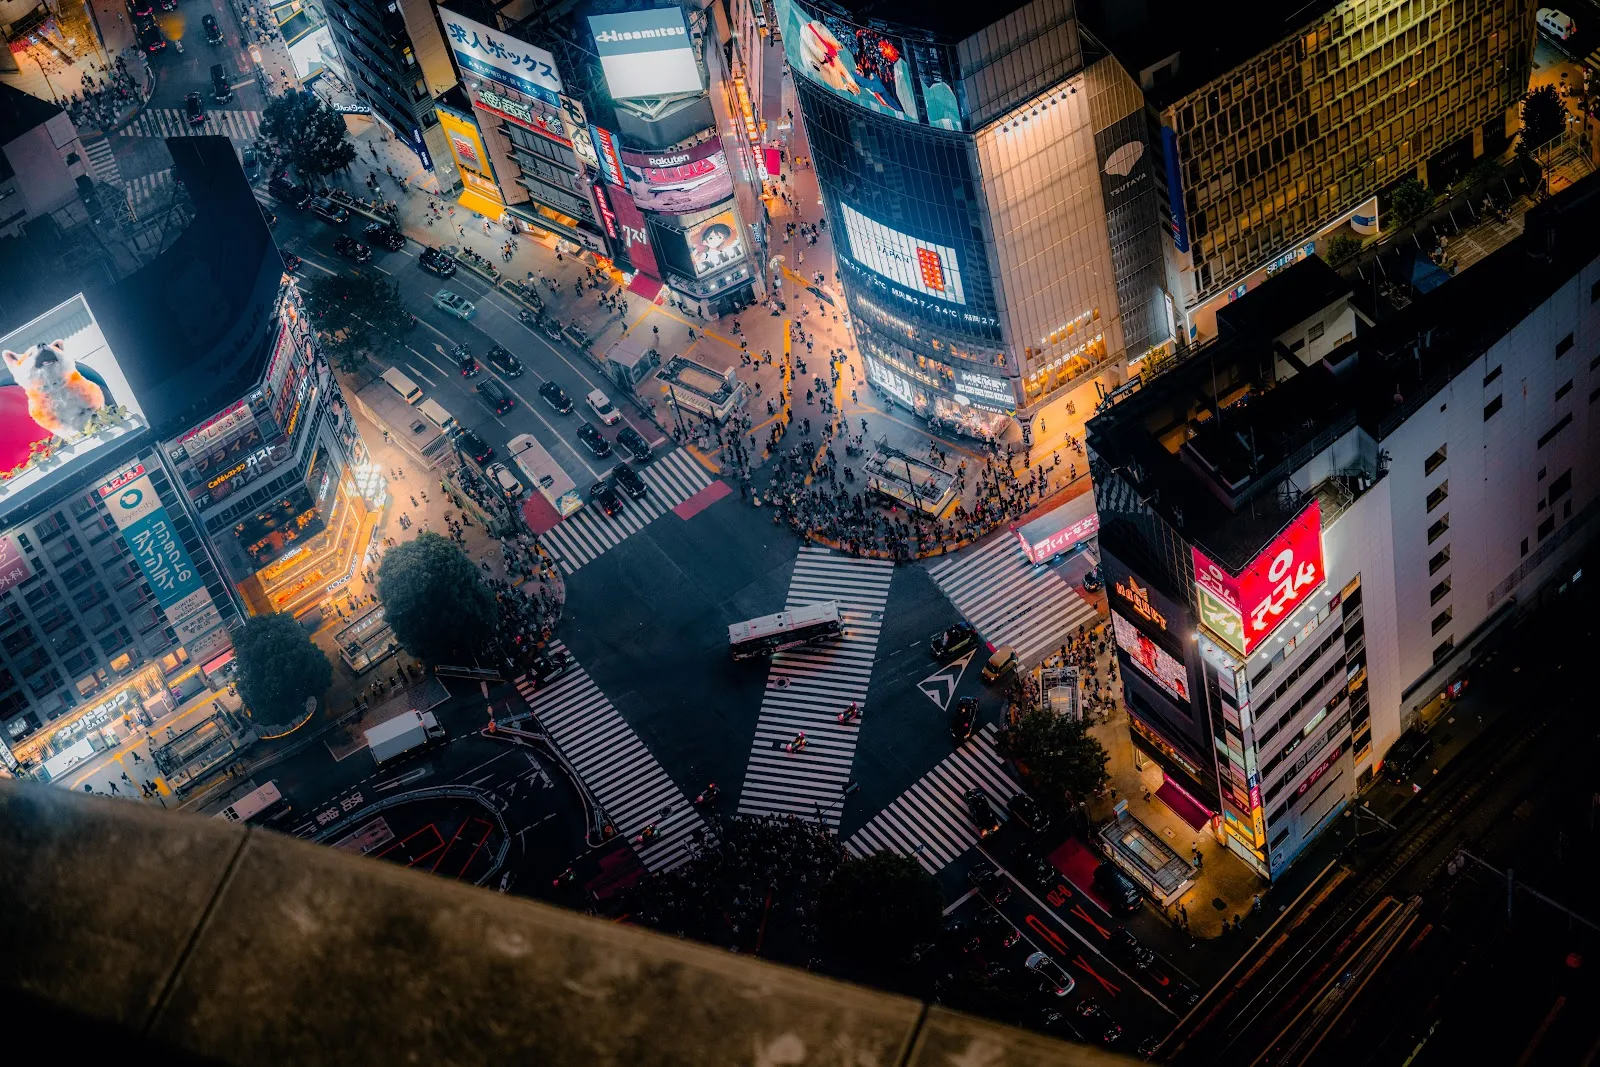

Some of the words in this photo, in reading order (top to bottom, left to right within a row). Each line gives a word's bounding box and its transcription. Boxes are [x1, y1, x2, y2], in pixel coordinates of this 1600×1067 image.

[447, 22, 558, 82] 求人ボックス
[598, 26, 684, 42] Hisamitsu
[649, 153, 690, 167] Rakuten
[1110, 173, 1147, 197] TSUTAYA
[870, 344, 939, 387] STARBUCKS
[1030, 334, 1102, 382] STARBUCKS
[973, 403, 1003, 414] TSUTAYA
[171, 449, 186, 461] 9F
[207, 463, 246, 489] Caféレストラン
[246, 445, 276, 467] ガスト
[231, 454, 270, 489] ガスト
[120, 500, 155, 523] eyecity
[195, 495, 210, 508] 7F
[131, 529, 175, 590] アイシティ
[152, 520, 192, 582] コンタクトの
[1200, 567, 1237, 606] アコム
[1251, 561, 1316, 631] アコム
[57, 691, 130, 741] サンドラッグ
